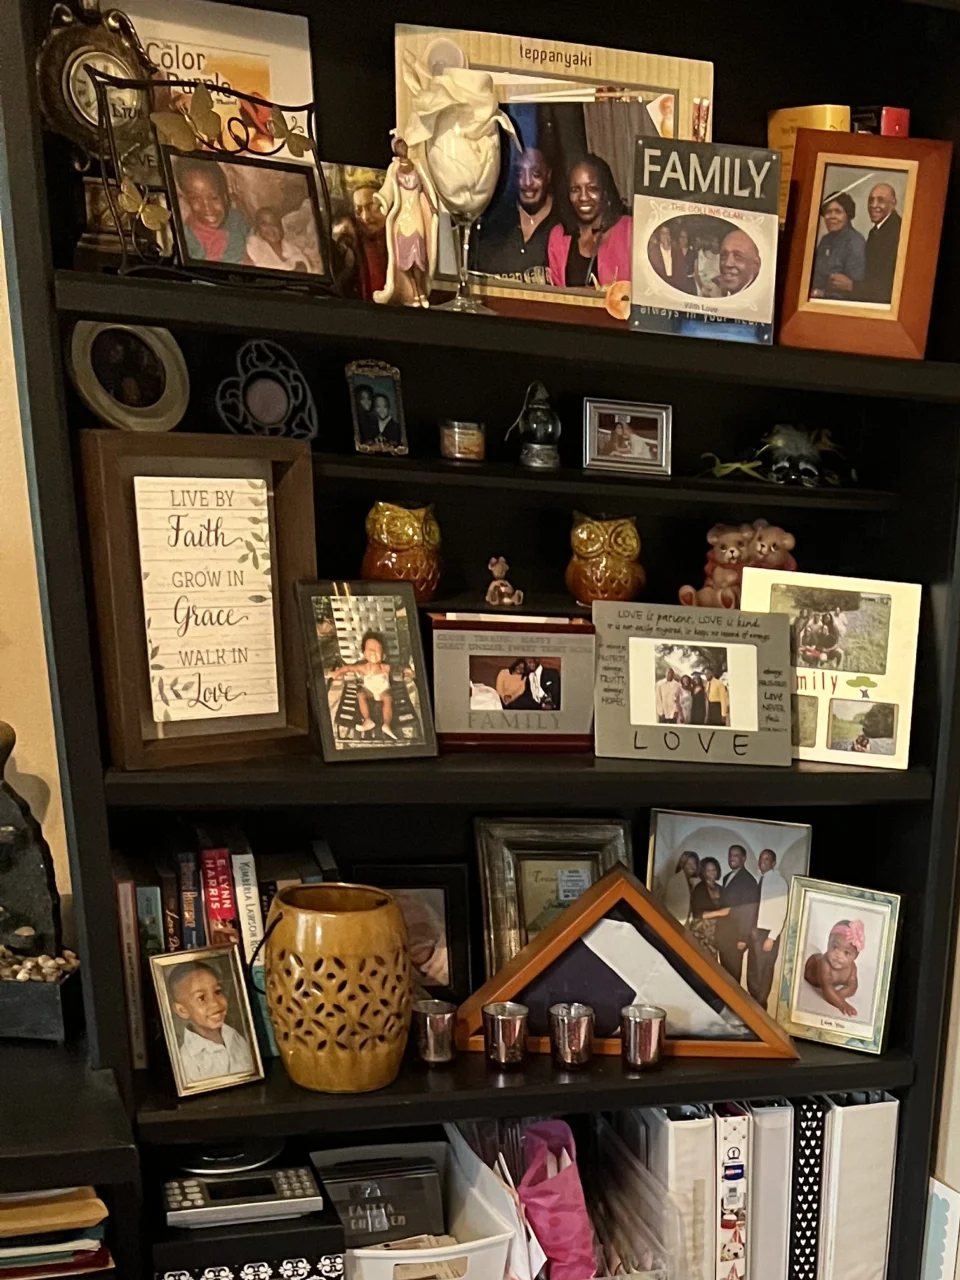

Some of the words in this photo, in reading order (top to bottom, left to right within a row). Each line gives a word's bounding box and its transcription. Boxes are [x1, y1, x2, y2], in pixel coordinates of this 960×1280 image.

[146, 42, 206, 70] Color
[519, 45, 592, 67] teppanyaki
[643, 148, 771, 198] FAMILY
[670, 202, 687, 213] THE
[171, 490, 209, 508] LIVE
[215, 489, 235, 507] BY
[167, 513, 243, 548] Faith
[172, 570, 222, 589] GROW
[227, 570, 245, 587] IN
[173, 595, 248, 638] Grace
[618, 610, 643, 619] LOVE
[698, 615, 722, 624] LOVE
[178, 648, 227, 667] WALK
[232, 647, 249, 664] IN
[187, 672, 247, 712] Love
[796, 671, 838, 695] mily
[764, 691, 783, 701] Love
[467, 712, 561, 730] FAMILY
[634, 730, 750, 755] LOVE
[217, 859, 226, 870] E.
[205, 859, 221, 909] HARRIS
[219, 875, 232, 909] LYNN
[246, 902, 258, 938] LAWSON
[250, 939, 262, 962] ROY
